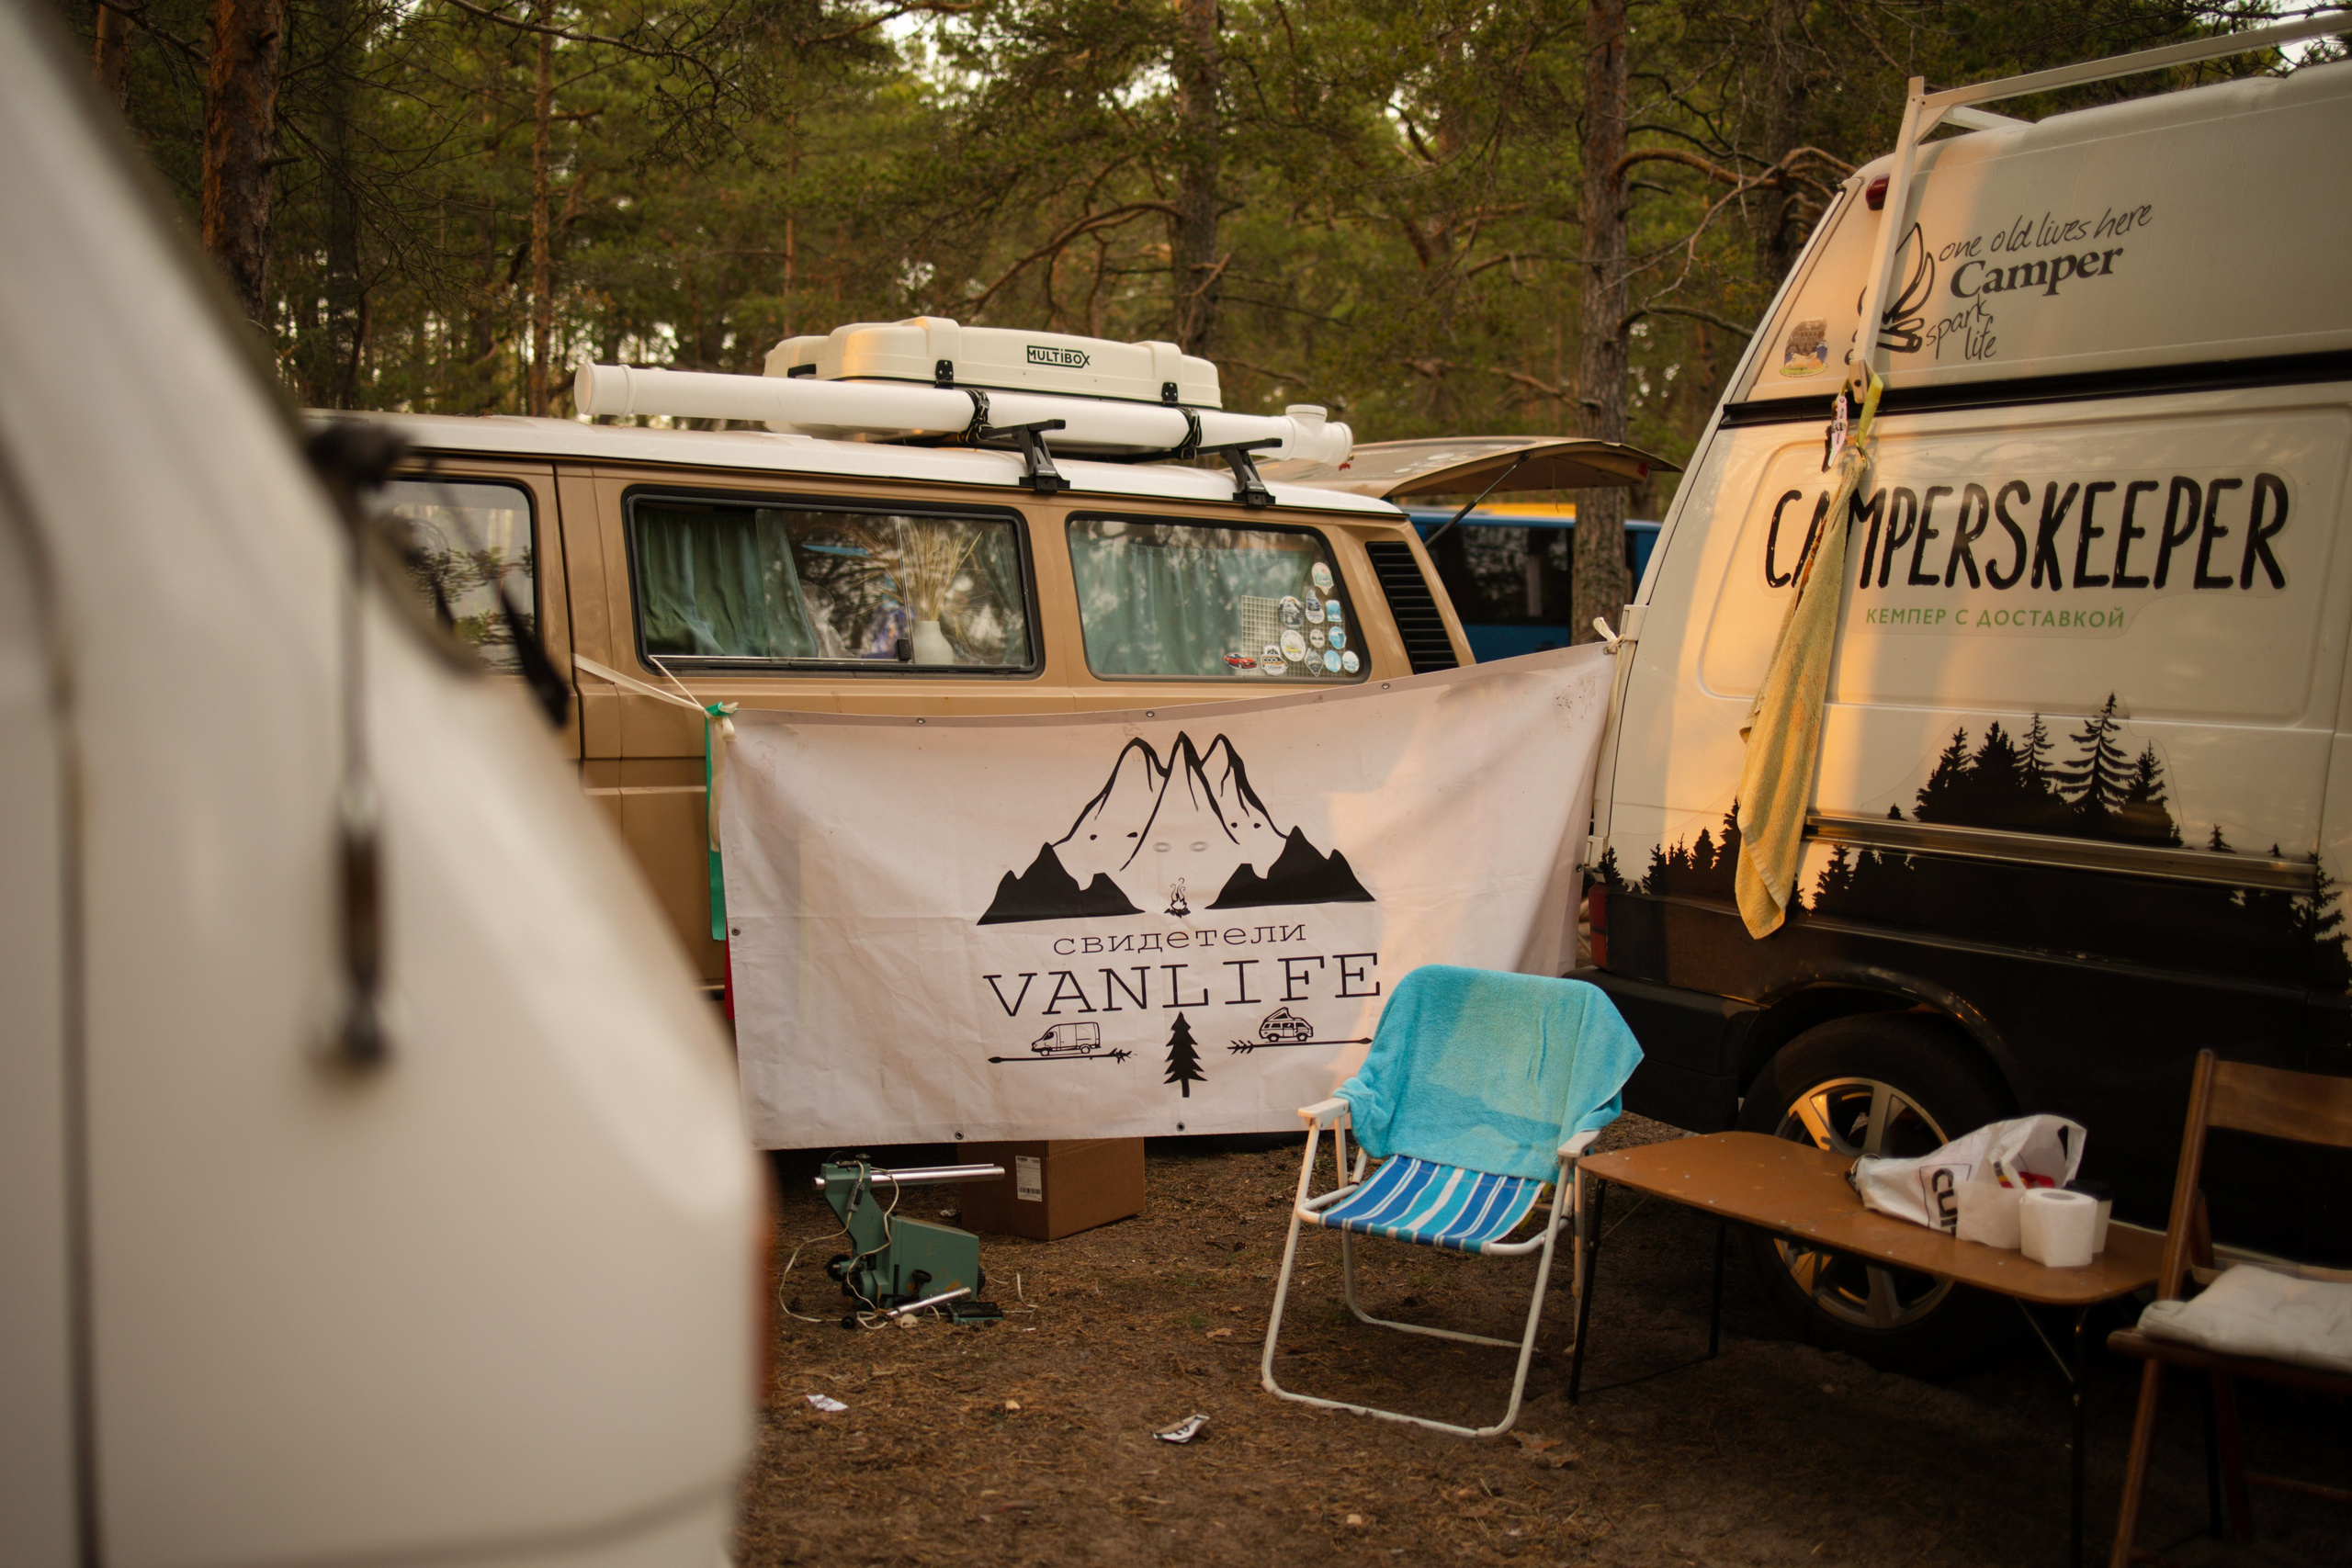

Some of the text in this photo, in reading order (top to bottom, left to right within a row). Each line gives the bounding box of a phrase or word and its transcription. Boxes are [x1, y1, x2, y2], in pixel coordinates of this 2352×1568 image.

[1939, 204, 2153, 262] one old lives here
[1950, 247, 2124, 299] Camper
[1926, 293, 1991, 361] spark
[1964, 315, 1997, 361] life
[1027, 348, 1091, 366] MULTIBOX
[1866, 607, 2124, 628] КЕМПЕР С ДОСТАВКОЙ
[1053, 924, 1306, 955] свидетели
[982, 953, 1381, 1017] VANLIFE
